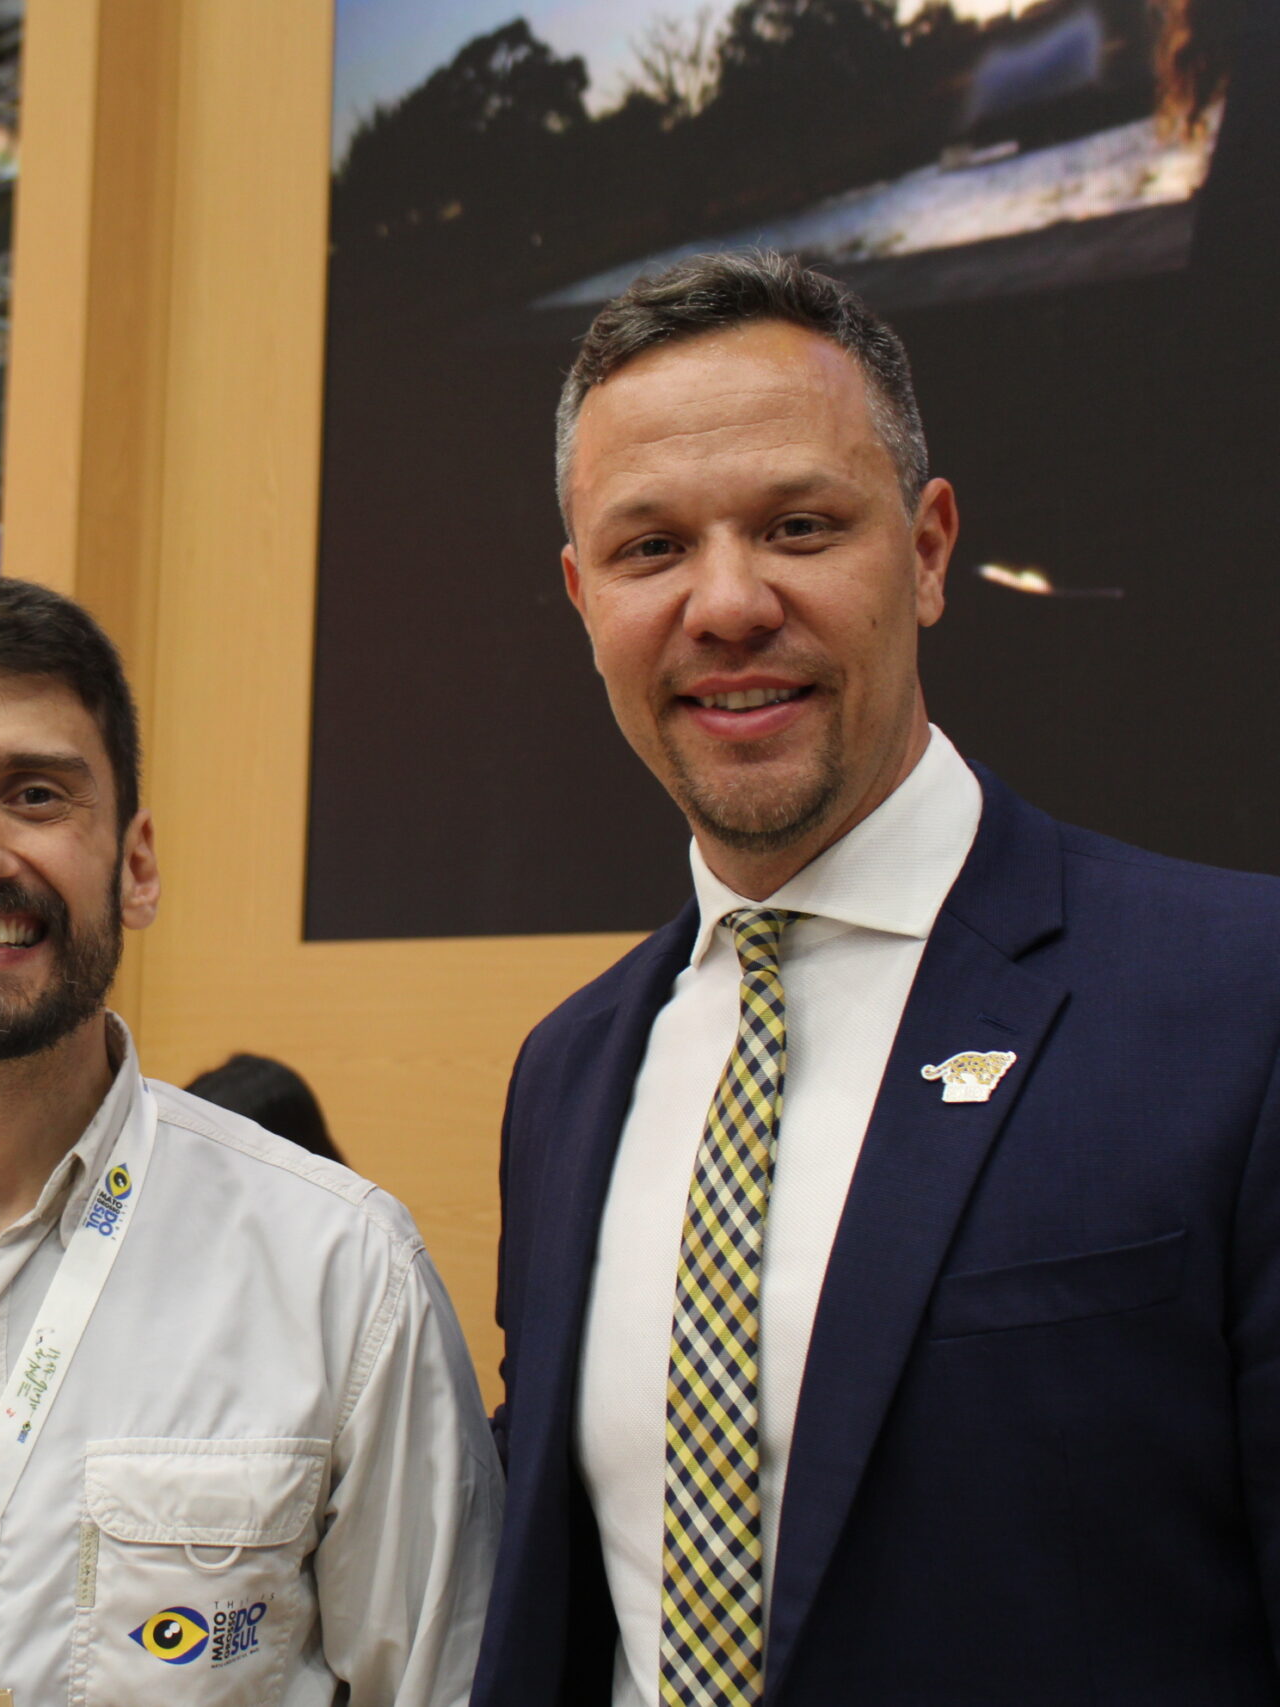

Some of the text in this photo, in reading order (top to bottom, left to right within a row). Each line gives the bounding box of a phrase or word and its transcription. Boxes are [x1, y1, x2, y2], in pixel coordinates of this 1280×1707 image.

[98, 1189, 123, 1209] MATO
[85, 1203, 105, 1230] SUL
[98, 1209, 118, 1237] DO
[234, 1602, 267, 1633] DO
[211, 1611, 226, 1660] MATO
[224, 1610, 237, 1659] GROSSO
[231, 1626, 258, 1655] SUL
